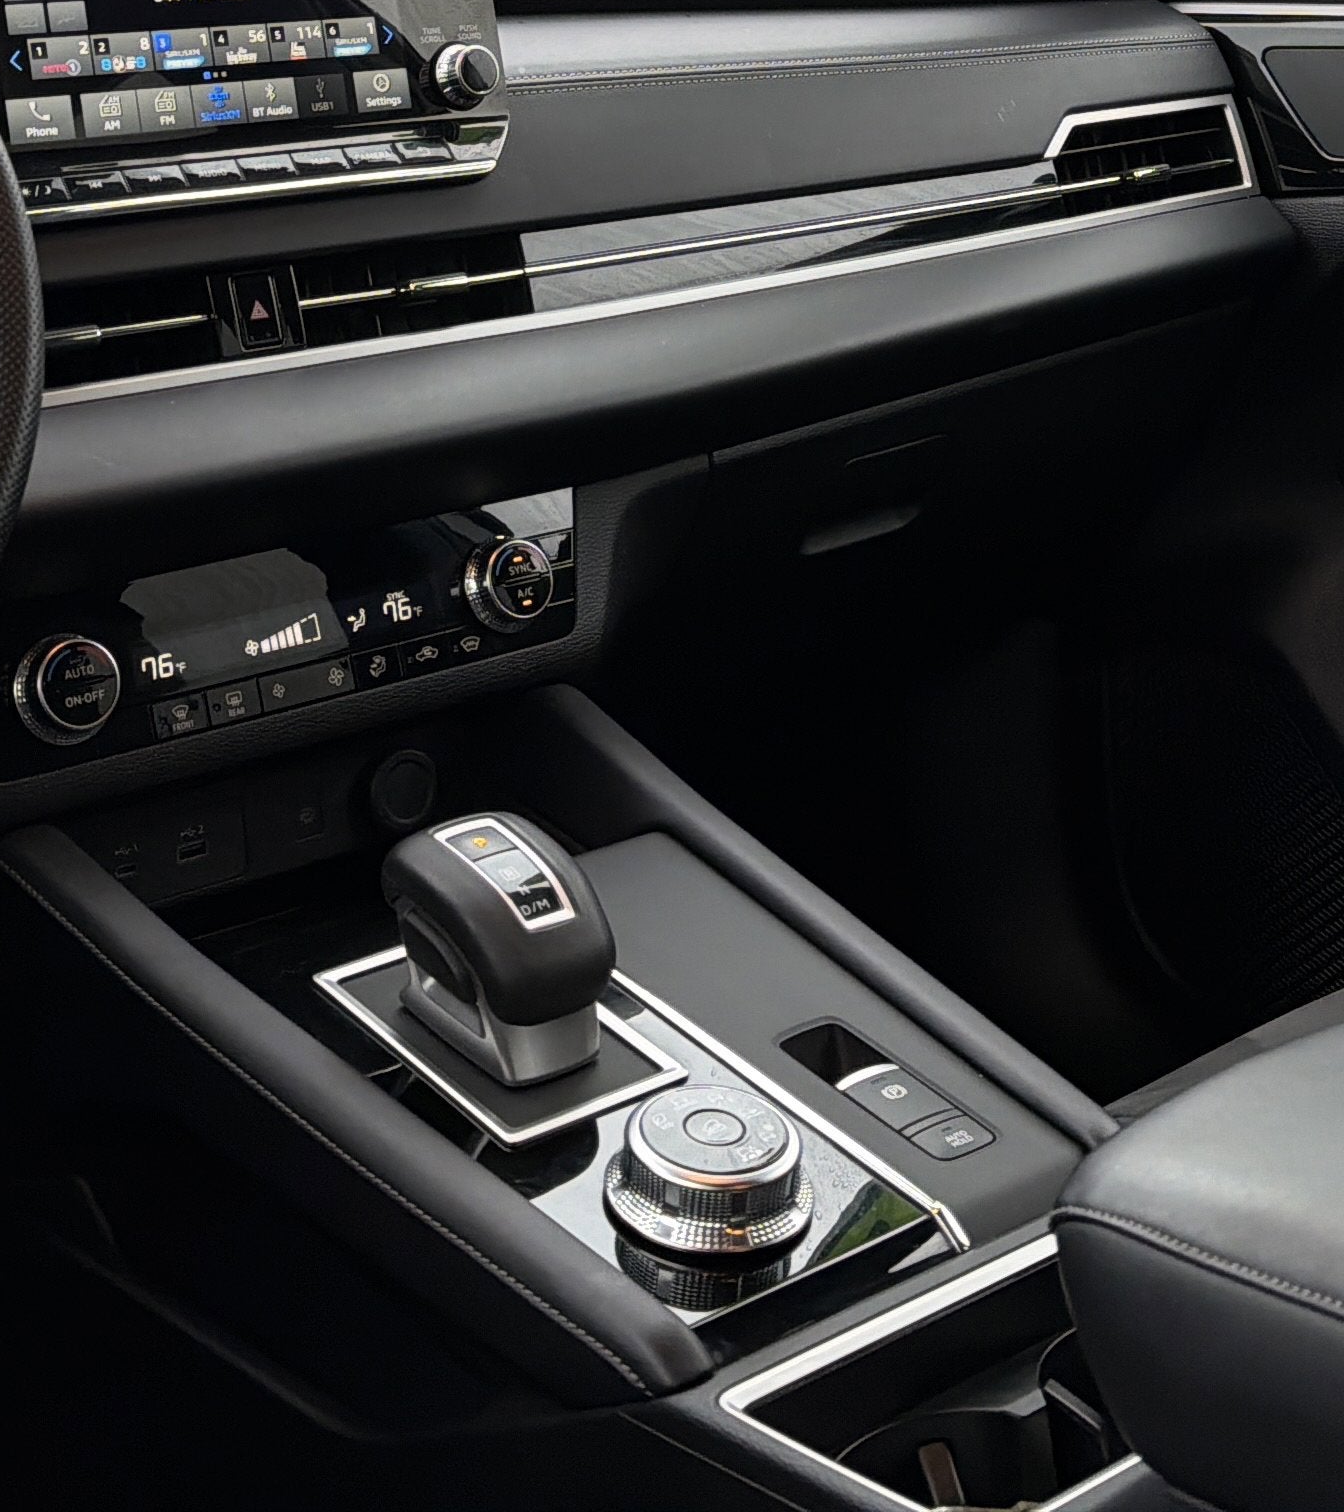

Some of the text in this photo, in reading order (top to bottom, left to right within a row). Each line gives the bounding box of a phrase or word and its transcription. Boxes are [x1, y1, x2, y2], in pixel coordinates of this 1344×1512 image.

[296, 25, 322, 39] 114
[329, 25, 337, 35] 6
[366, 22, 374, 34] 1
[200, 33, 208, 46] 1
[218, 34, 225, 44] 4
[248, 29, 266, 43] 56
[274, 30, 282, 40] 5
[78, 41, 89, 55] 2
[98, 41, 106, 52] 2
[140, 37, 151, 51] 8
[159, 38, 167, 48] 3
[36, 46, 42, 56] 1
[311, 101, 335, 112] USB1
[365, 96, 402, 107] Settings
[252, 104, 293, 117] BT Audio
[104, 120, 120, 131] AM
[160, 115, 175, 125] FM
[26, 126, 58, 138] Phone
[508, 562, 533, 577] SYNC
[386, 590, 406, 601] SYNC
[517, 586, 535, 599] A/C
[64, 664, 95, 680] AUTO
[172, 719, 195, 733] FRONT
[520, 898, 551, 916] D/M
